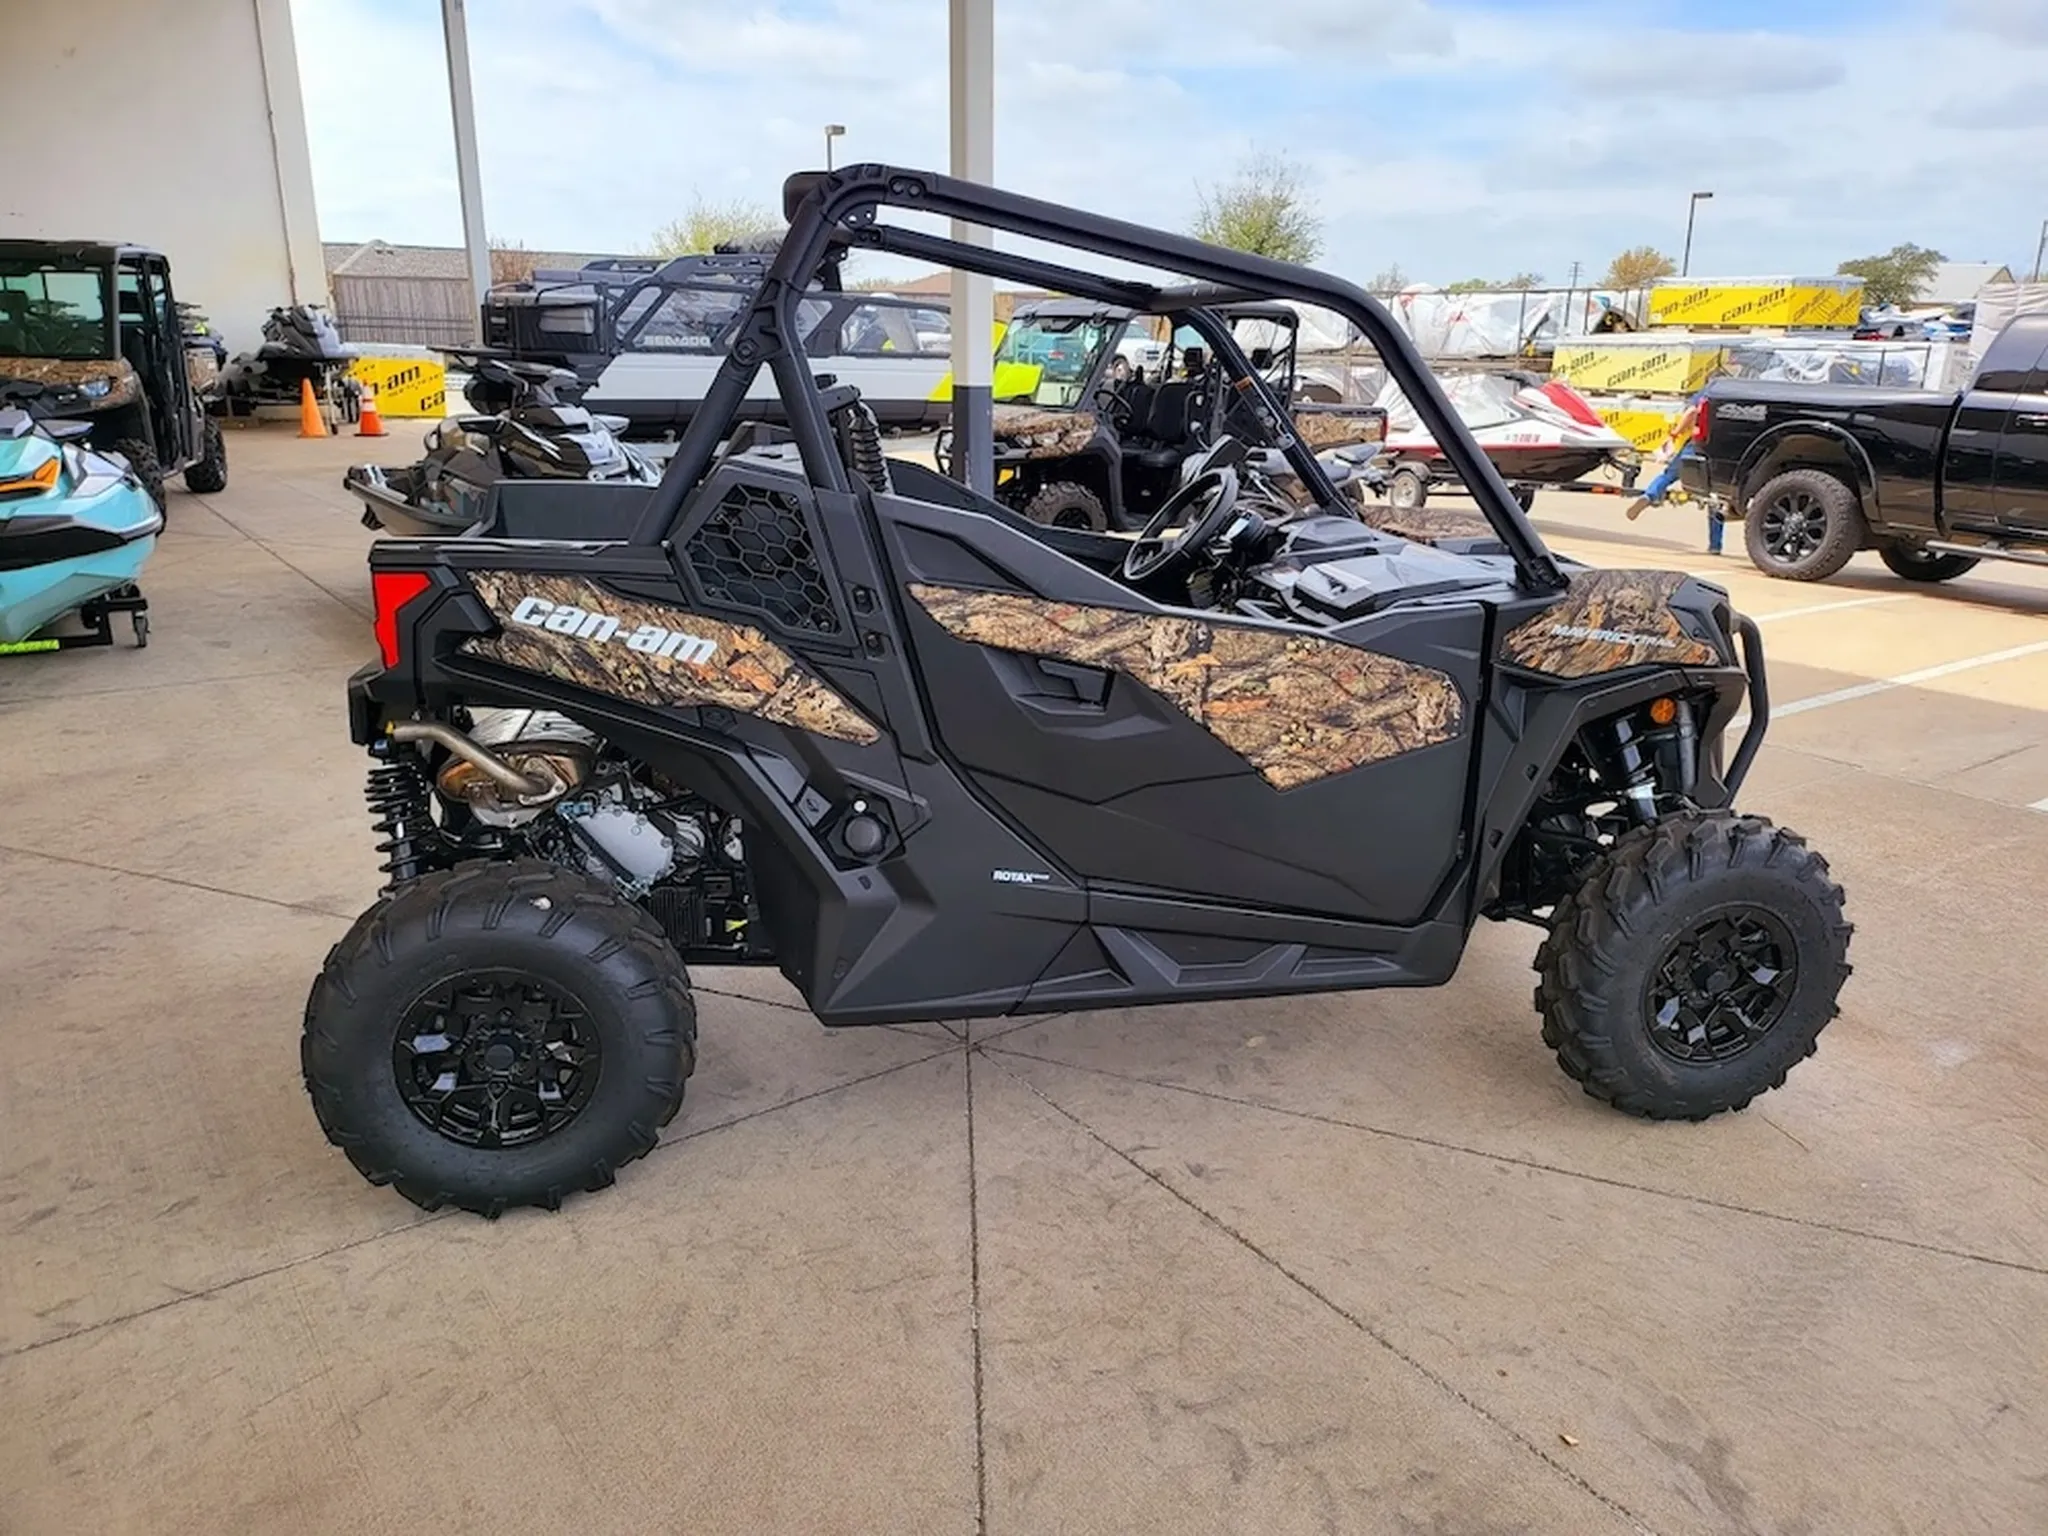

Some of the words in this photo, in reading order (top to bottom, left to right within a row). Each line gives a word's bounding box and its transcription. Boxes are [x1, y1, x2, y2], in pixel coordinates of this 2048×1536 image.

[1721, 288, 1785, 322] can-am
[1607, 352, 1668, 387] can-am
[511, 596, 717, 664] can-am
[993, 870, 1033, 883] ROTAX
